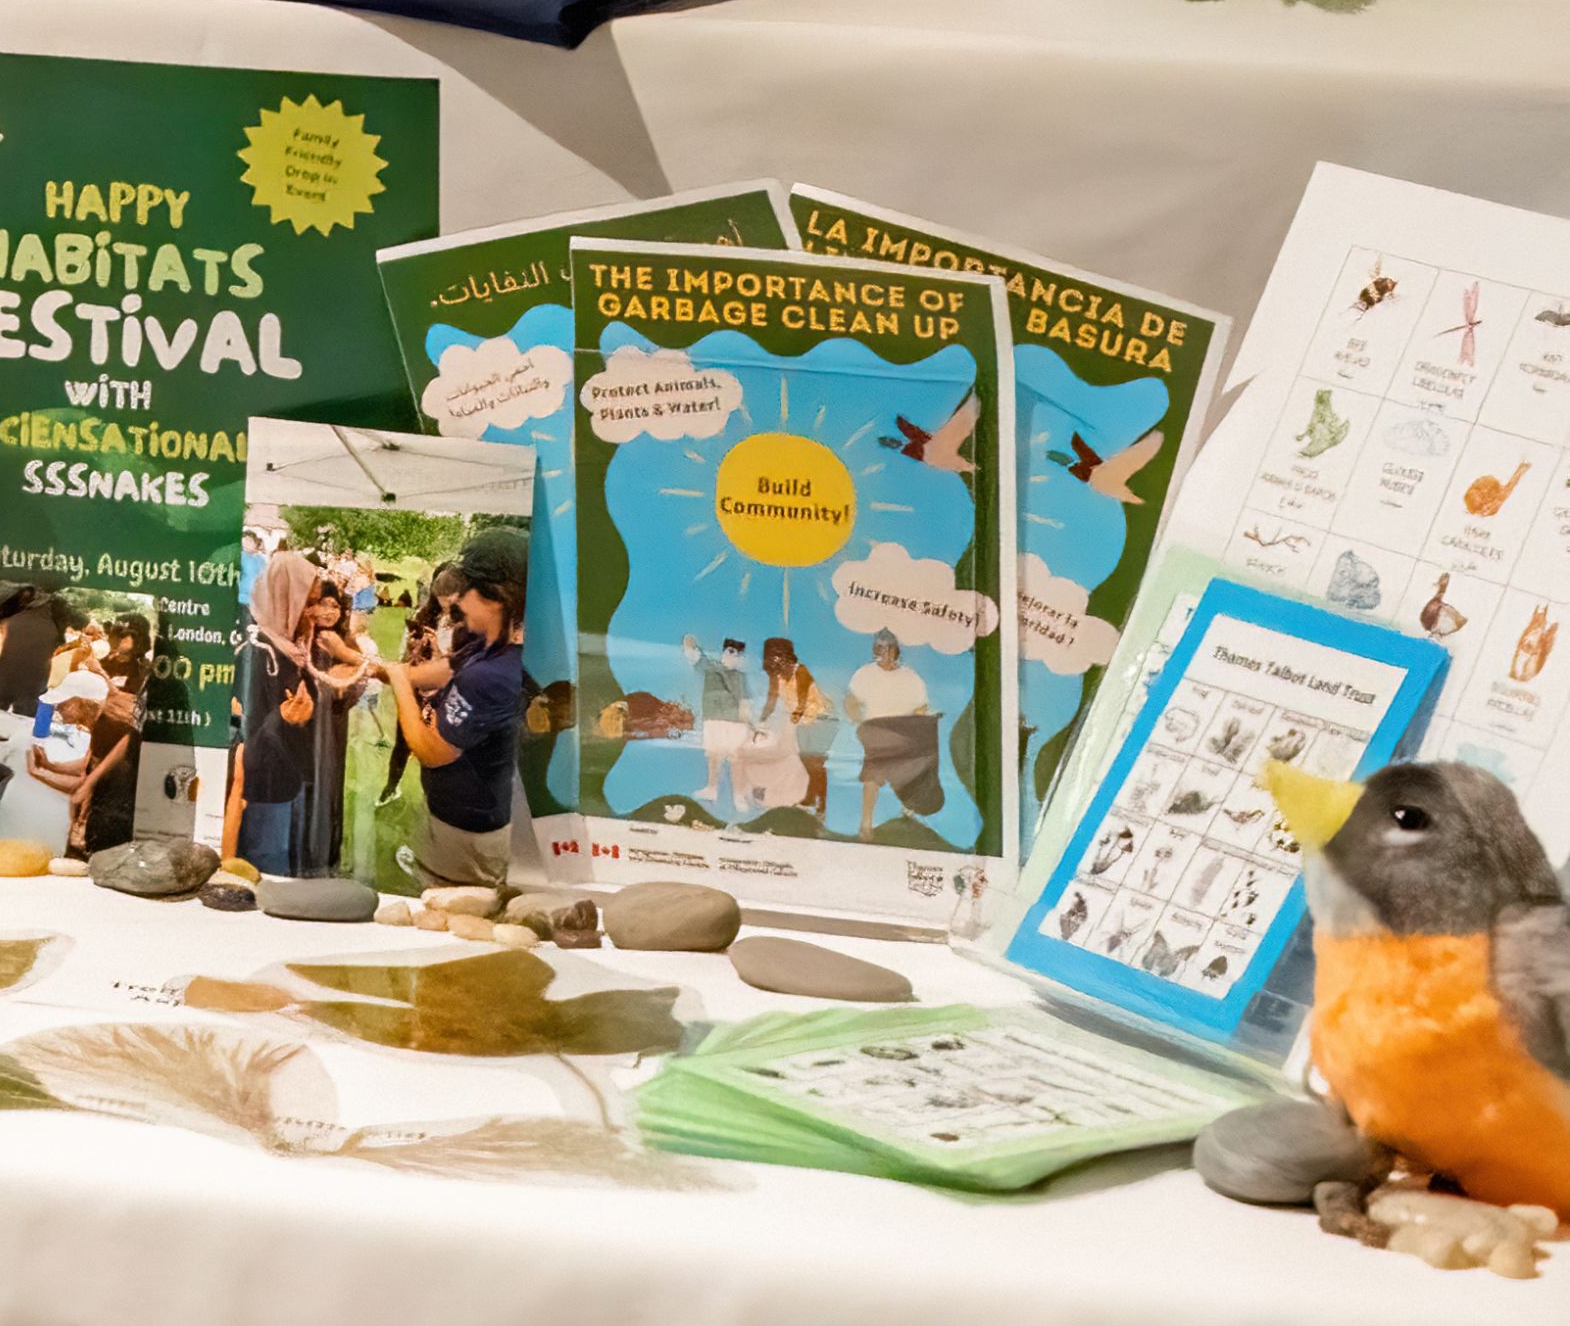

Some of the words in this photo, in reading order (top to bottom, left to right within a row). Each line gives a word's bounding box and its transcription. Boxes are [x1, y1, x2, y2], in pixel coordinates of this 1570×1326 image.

[45, 180, 190, 229] HAPPY
[589, 264, 654, 291] THE
[666, 268, 906, 309] IMPORTANCE
[919, 289, 965, 314] OF
[807, 210, 848, 245] LA
[1140, 310, 1189, 346] DE
[598, 293, 768, 328] GARBAGE
[781, 306, 899, 335] CLEAN
[914, 314, 960, 340] UP
[1026, 307, 1172, 373] BASURA
[22, 459, 211, 507] SSSNAKES
[757, 475, 812, 496] Build
[720, 496, 851, 526] Community!
[97, 552, 182, 587] August
